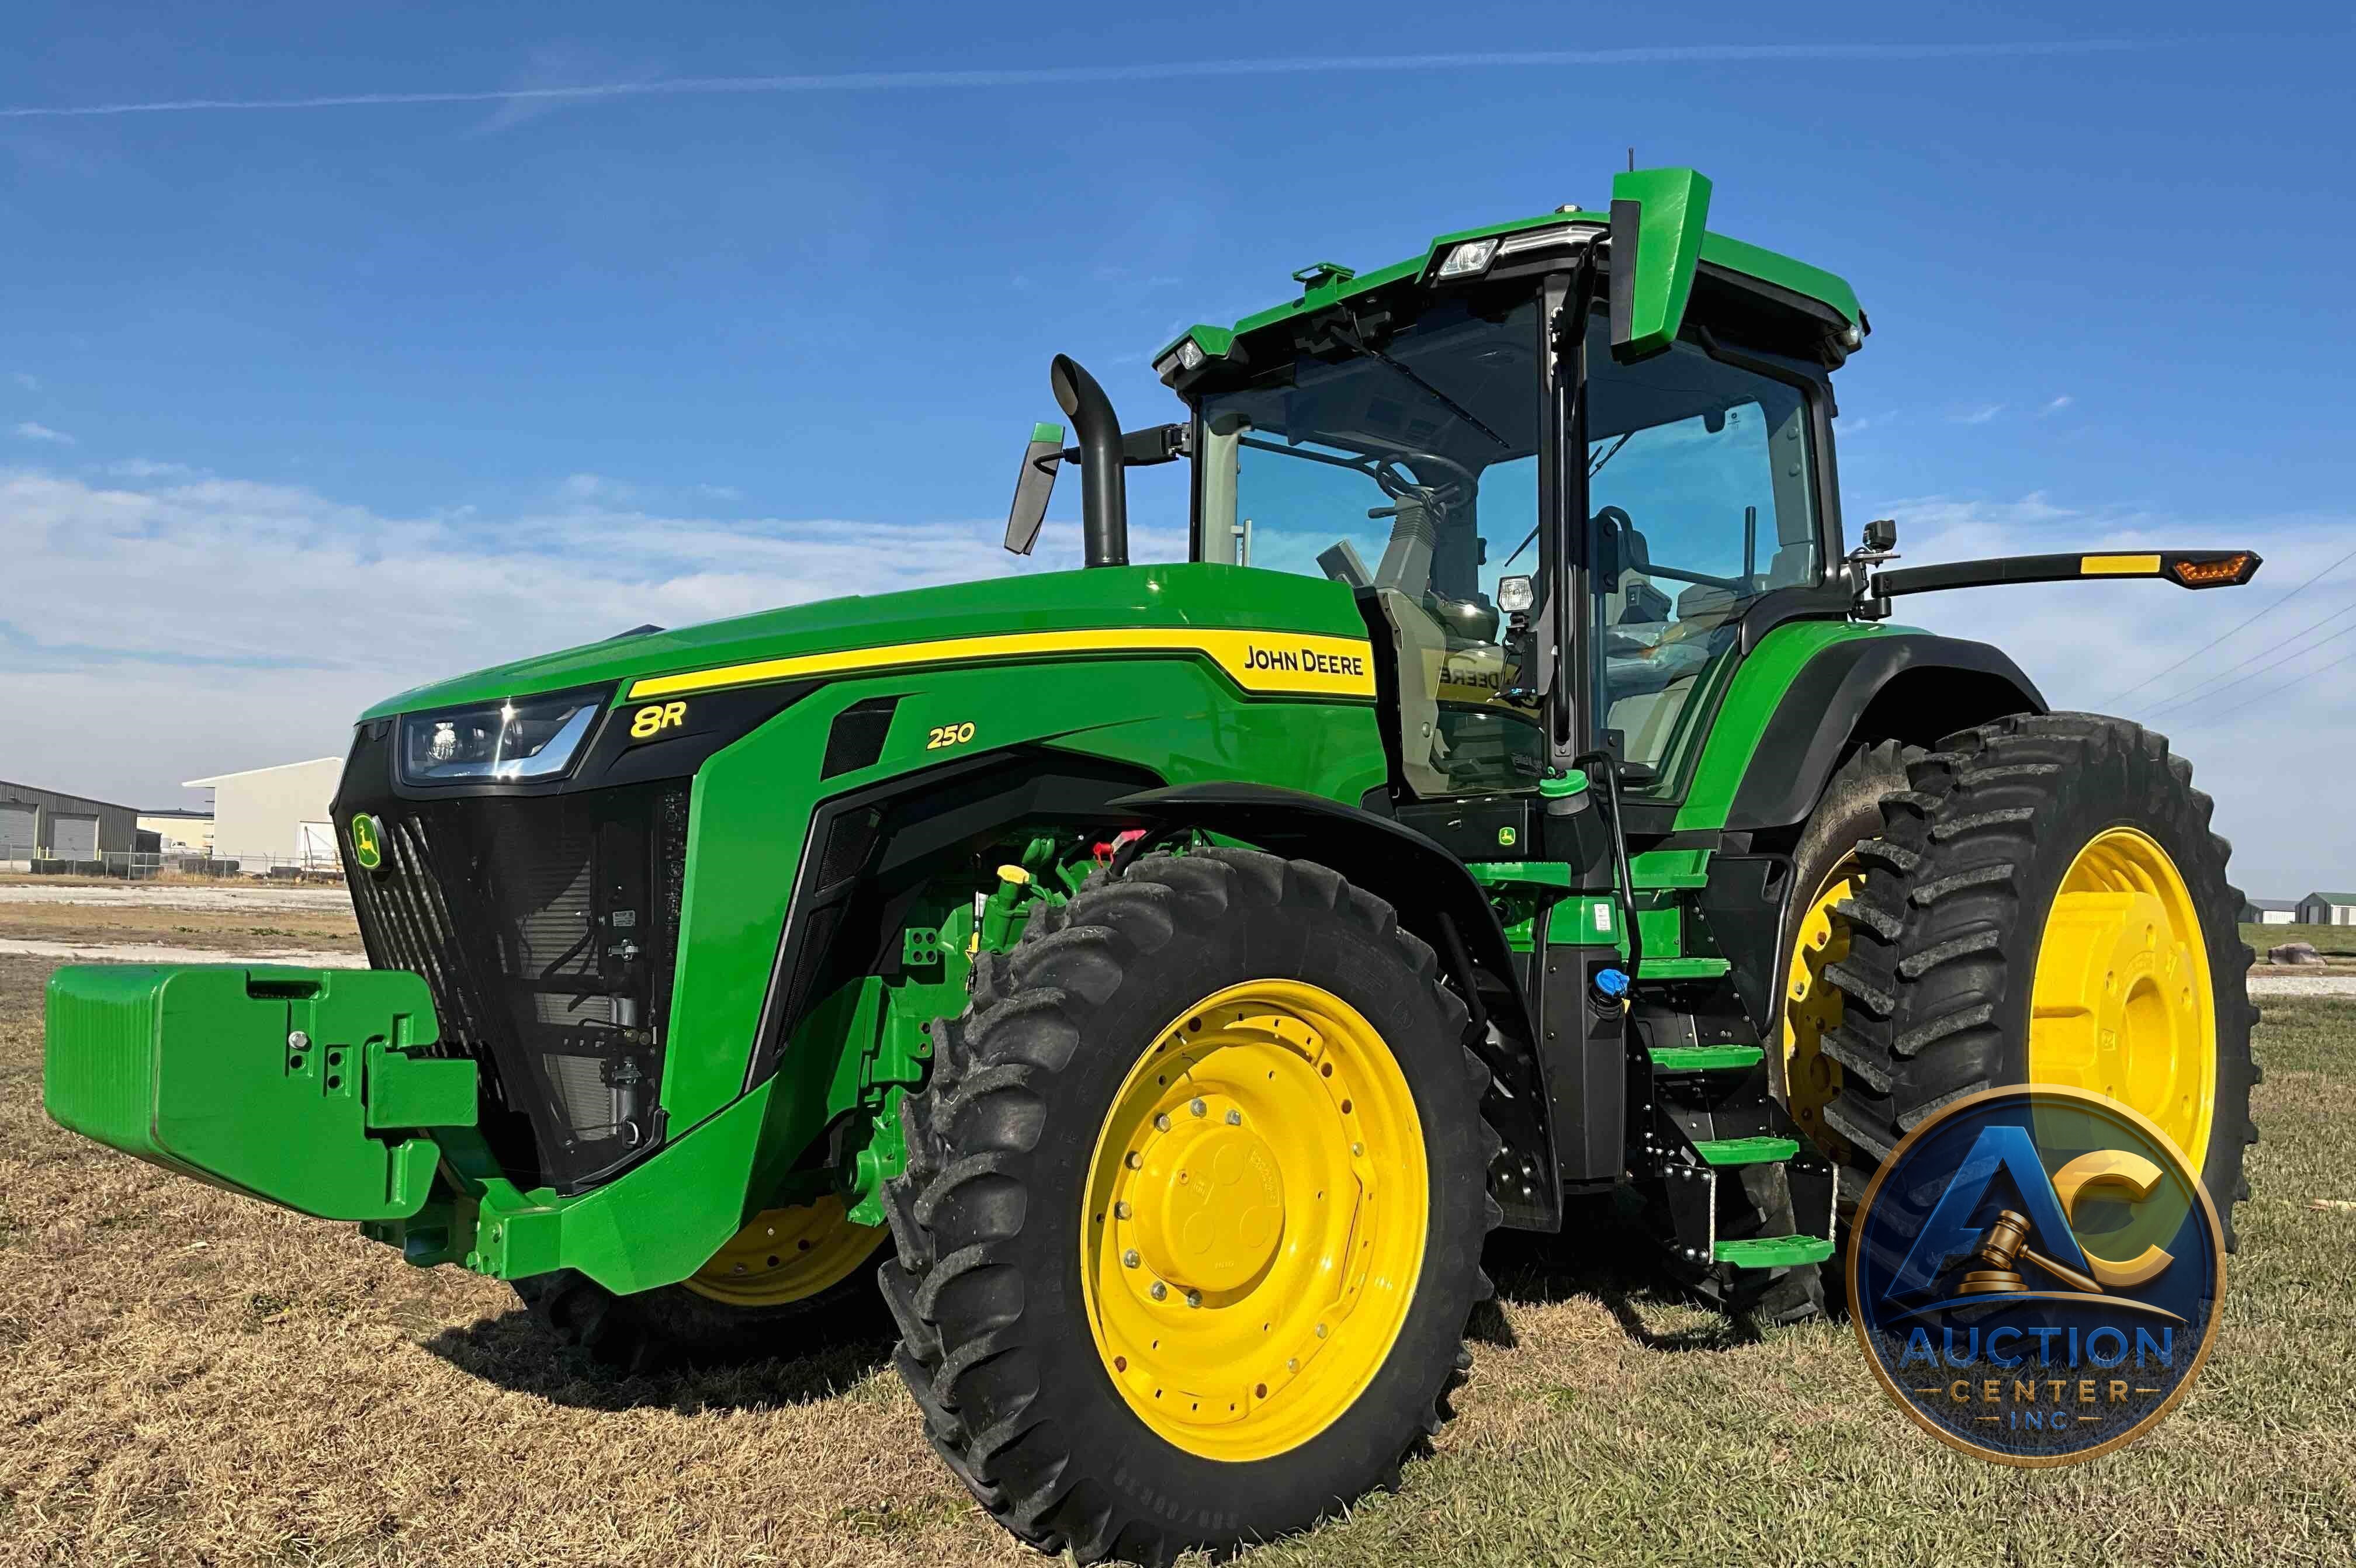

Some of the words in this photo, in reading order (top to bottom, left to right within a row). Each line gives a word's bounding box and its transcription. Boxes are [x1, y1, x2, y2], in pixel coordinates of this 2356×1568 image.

[1245, 645, 1298, 671] JOHN
[1301, 648, 1363, 675] DEERE
[630, 701, 687, 737] 8R
[926, 721, 975, 750] 250
